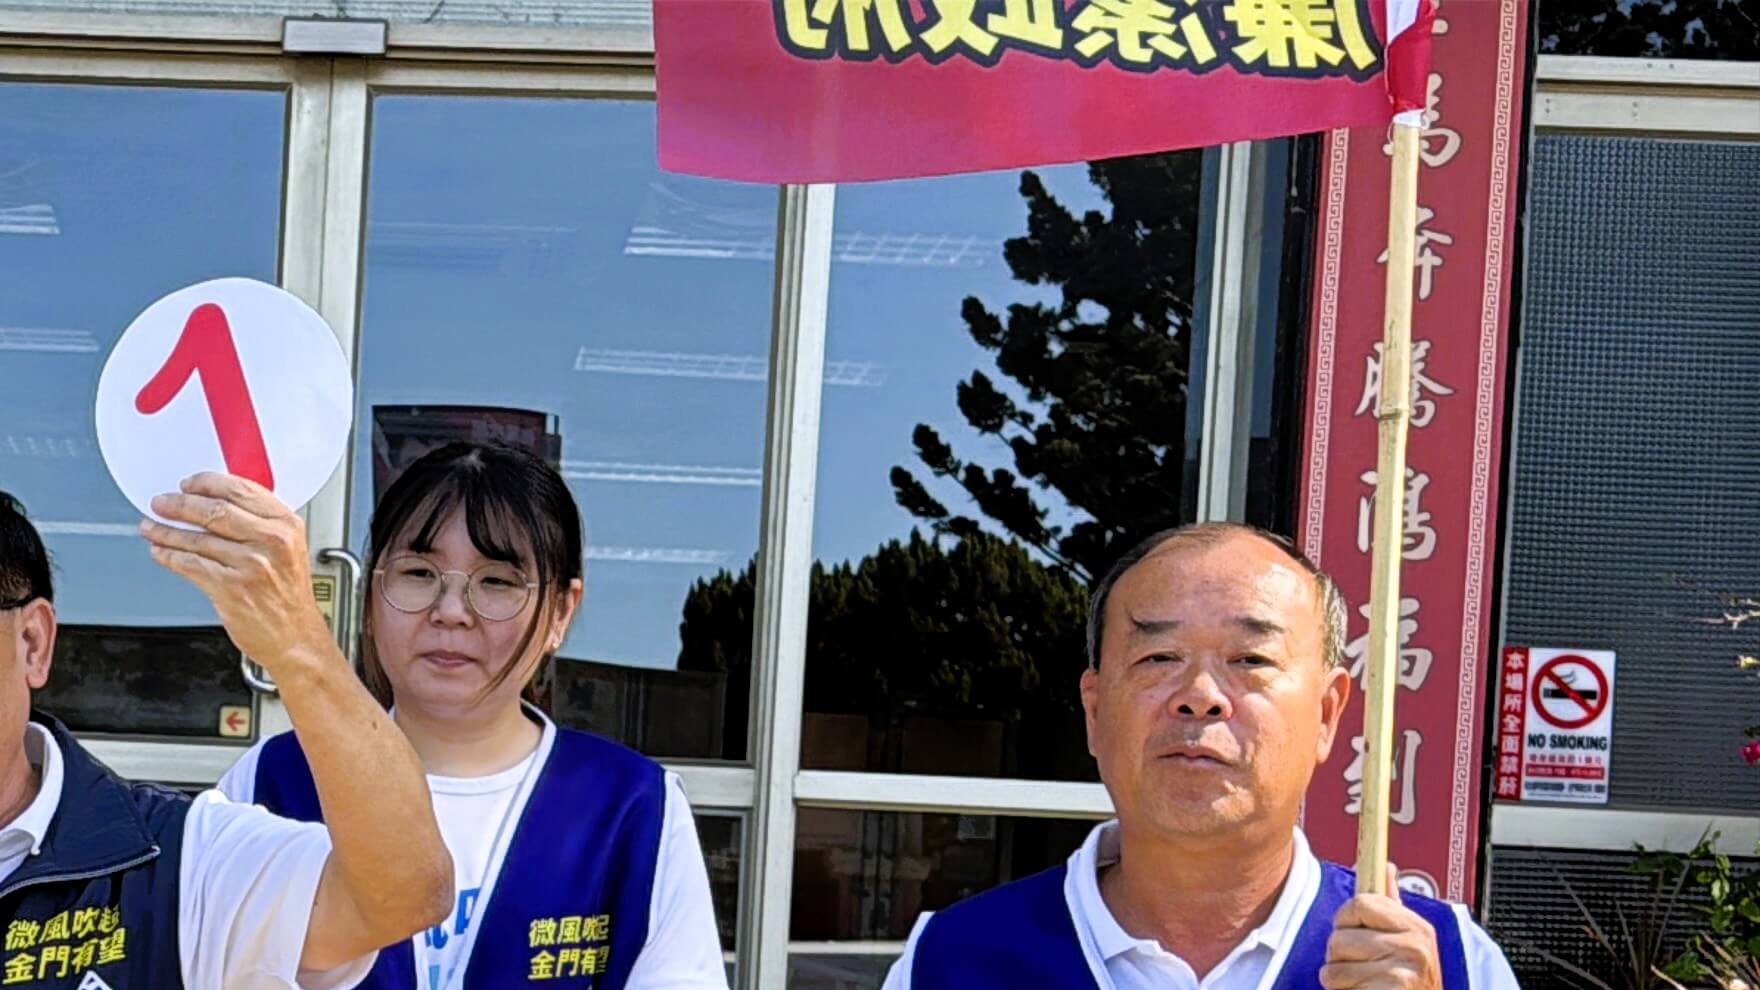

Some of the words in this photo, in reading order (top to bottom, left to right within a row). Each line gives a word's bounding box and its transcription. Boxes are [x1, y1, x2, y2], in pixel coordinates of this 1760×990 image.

[134, 302, 275, 493] 1
[1344, 0, 1461, 826] 馬奔騰鴻福到
[1527, 733, 1546, 749] NO
[1549, 733, 1608, 751] SMOKING
[2, 927, 126, 985] 金門有望
